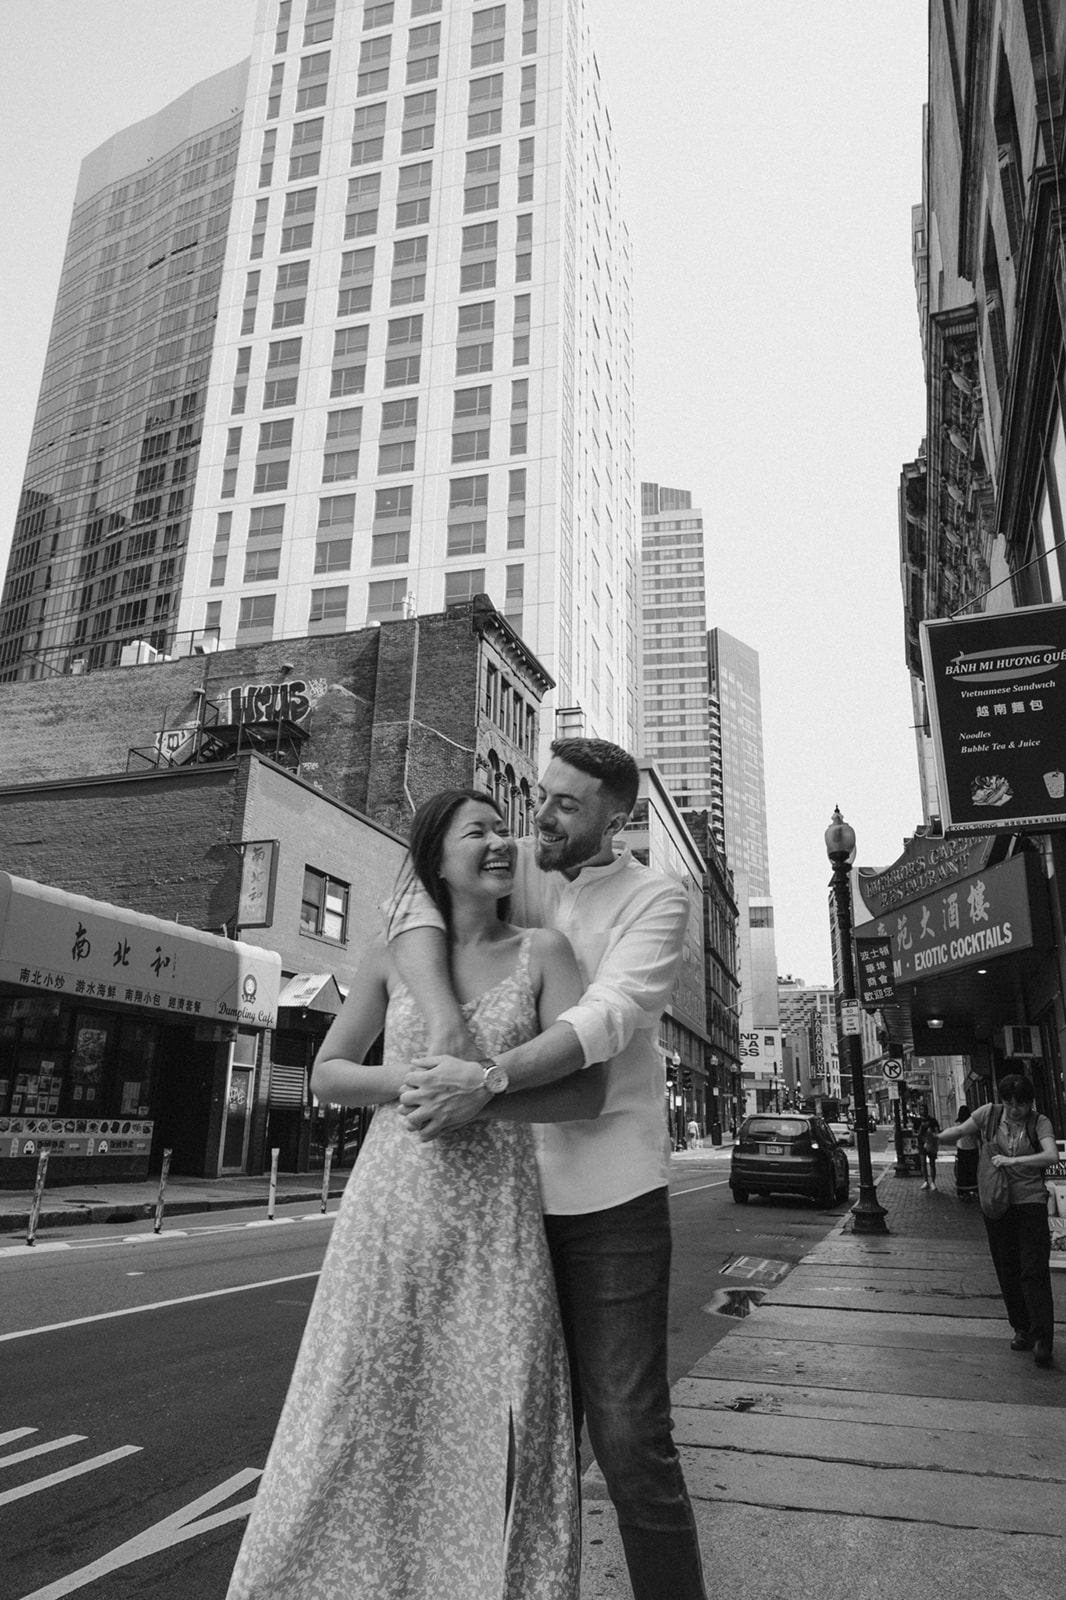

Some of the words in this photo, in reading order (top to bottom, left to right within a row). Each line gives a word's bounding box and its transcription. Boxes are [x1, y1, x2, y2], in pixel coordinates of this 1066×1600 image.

[960, 686, 1011, 698] Vietnamese
[1012, 680, 1056, 693] Sandwich
[959, 731, 992, 741] Noodles
[961, 744, 990, 754] Bubble
[991, 743, 1006, 751] Tea
[1008, 741, 1016, 749] &
[1017, 739, 1041, 748] Juice
[914, 943, 948, 971] EXOTIC
[950, 922, 1013, 960] COCKTAILS
[19, 968, 66, 990] 南北小炒
[218, 1001, 256, 1024] Dumpling
[748, 1040, 759, 1048] A
[814, 1011, 824, 1078] PARAMOUNT
[918, 1058, 926, 1067] P
